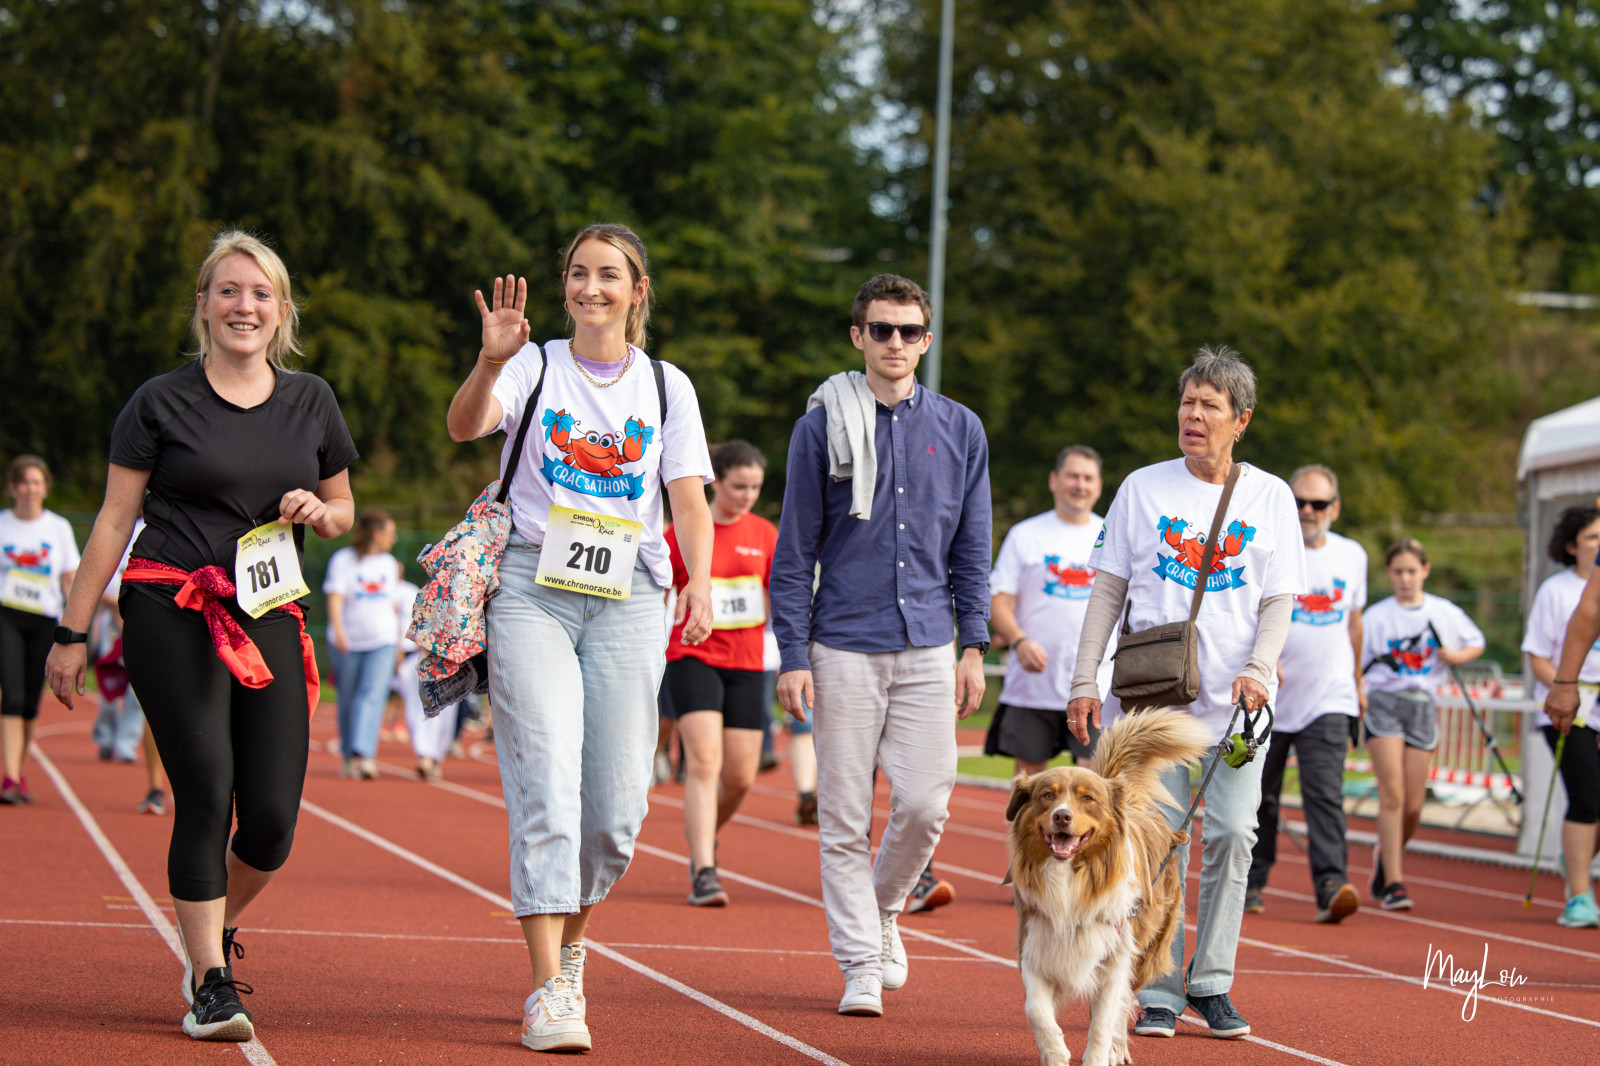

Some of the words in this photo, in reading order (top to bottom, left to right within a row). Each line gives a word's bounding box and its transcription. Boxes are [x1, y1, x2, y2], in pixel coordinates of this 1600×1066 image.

[552, 465, 631, 493] CRAC'SATHON
[598, 525, 615, 536] Race
[566, 541, 612, 575] 210
[246, 555, 280, 594] 781
[544, 575, 623, 597] www.chronorace.be
[1165, 561, 1234, 588] CRAC'STHON
